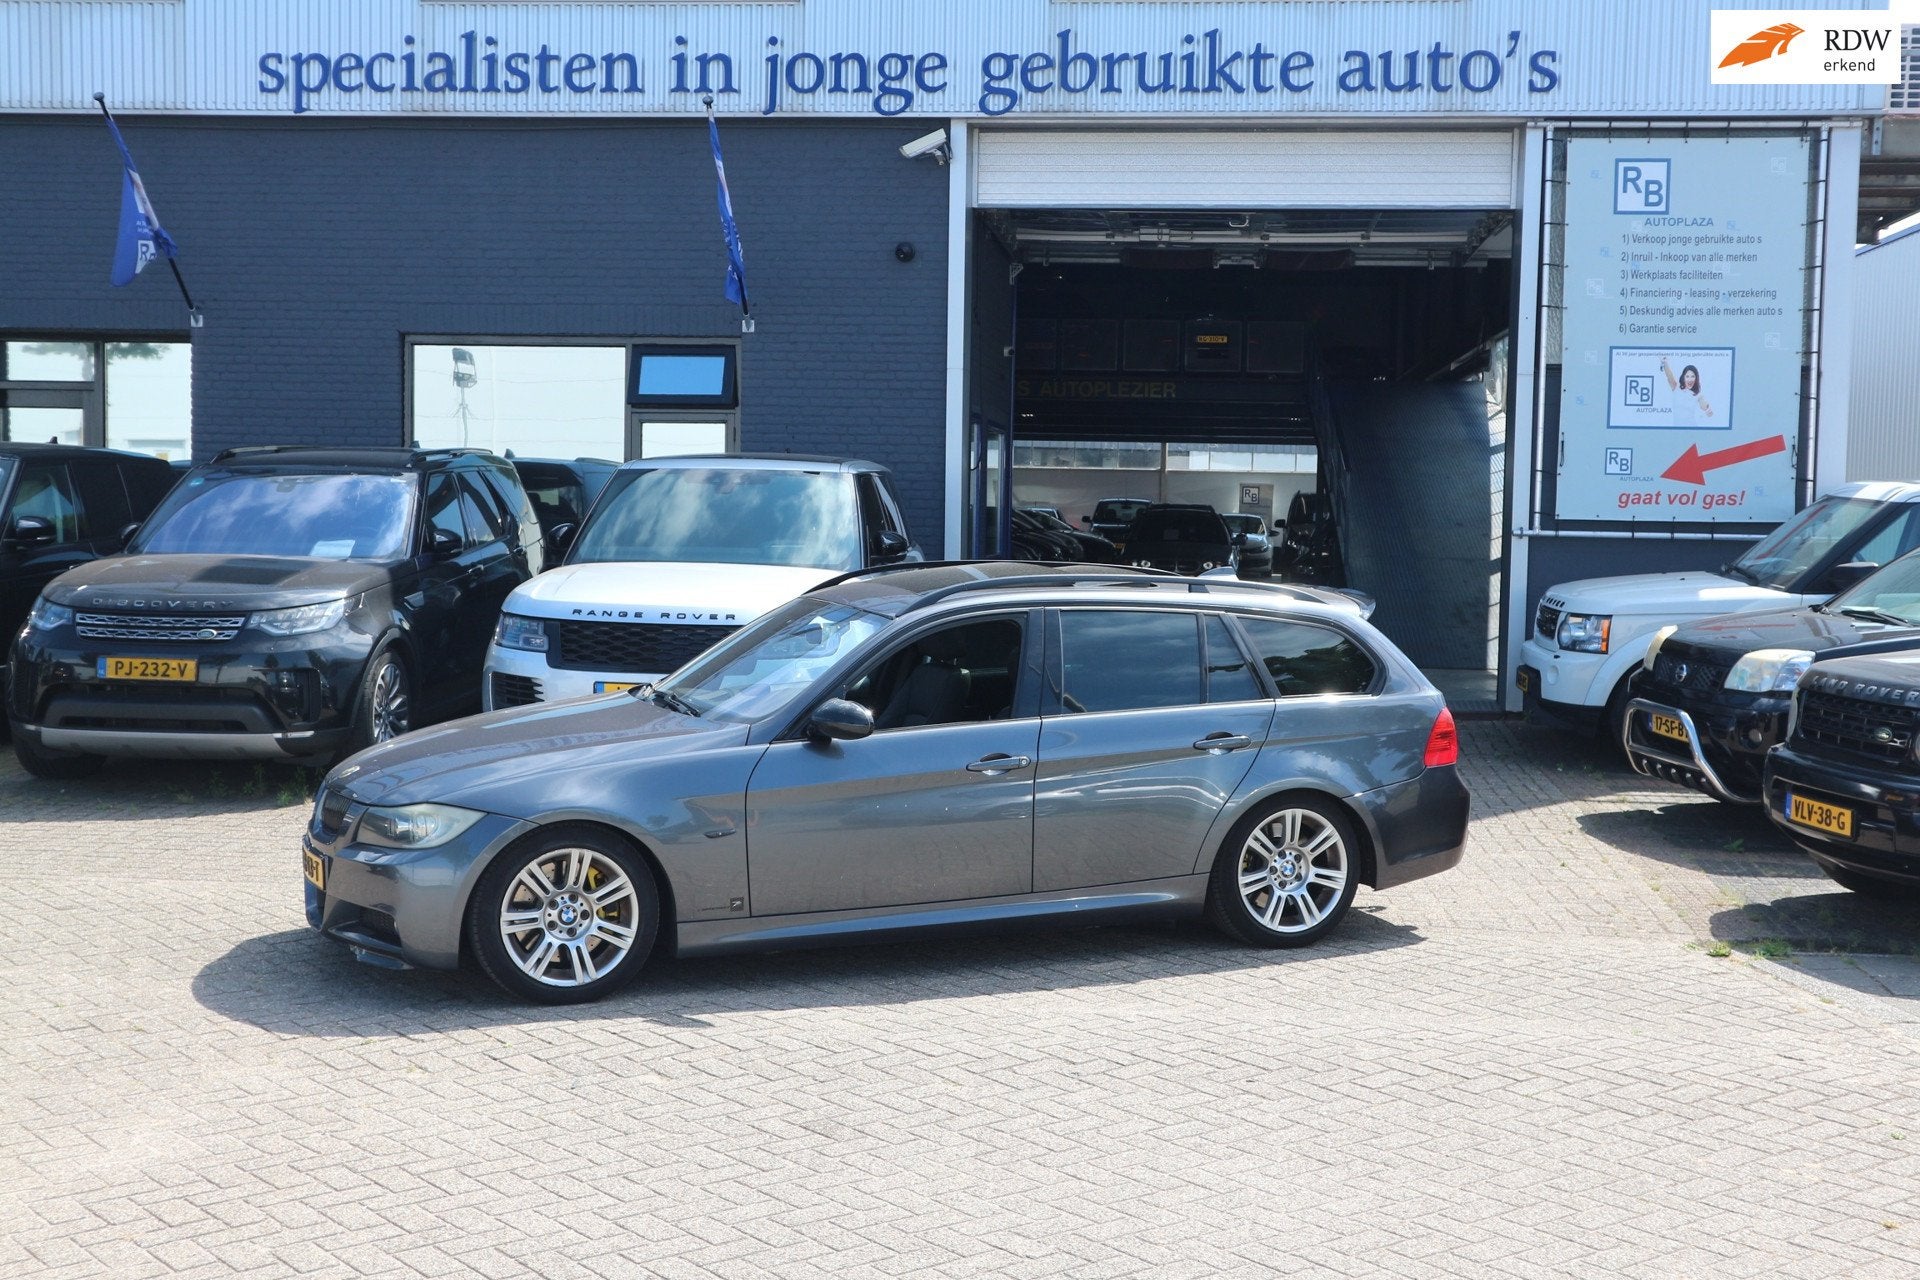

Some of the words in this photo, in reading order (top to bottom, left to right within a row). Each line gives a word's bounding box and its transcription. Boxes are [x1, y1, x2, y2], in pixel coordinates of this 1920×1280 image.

[258, 30, 645, 114] specialisten
[670, 35, 739, 93] in
[762, 35, 948, 116] jonge
[978, 28, 1315, 116] gebruikte
[1622, 166, 1664, 207] RB
[1644, 217, 1714, 227] AUTOPLAZA
[1622, 234, 1630, 245] 1)
[1632, 234, 1666, 246] Verkoop
[1668, 234, 1692, 246] jonge
[1694, 234, 1734, 246] gebruikte
[1621, 252, 1629, 263] 2)
[1632, 252, 1652, 261] Inruil
[1660, 252, 1689, 263] Inkoop
[1692, 254, 1706, 262] van
[1709, 252, 1724, 262] alle
[1726, 252, 1758, 262] merken
[1620, 270, 1628, 281] 3)
[1630, 270, 1676, 281] Werkplaats
[1680, 270, 1723, 280] faciliteiten
[1620, 288, 1628, 299] 4)
[1630, 288, 1682, 300] Financiering
[1690, 288, 1720, 300] leasing
[1728, 288, 1776, 300] verzekering
[1620, 306, 1628, 317] 5)
[1630, 306, 1674, 318] Deskundig
[1676, 306, 1704, 316] advies
[1706, 306, 1721, 316] alle
[1723, 306, 1754, 316] merken
[1757, 307, 1775, 316] auto
[1778, 308, 1782, 316] s
[1619, 324, 1626, 335] 6)
[1629, 323, 1664, 333] Garantie
[1666, 324, 1697, 333] service
[1040, 380, 1177, 398] AUTOPLEZIER
[1629, 380, 1650, 402] RB
[1609, 452, 1630, 472] RB
[1244, 488, 1258, 502] RB
[1618, 490, 1662, 508] gaat
[1667, 490, 1698, 506] vol
[1702, 490, 1746, 510] gas!
[572, 608, 643, 618] RANGE
[660, 612, 736, 620] ROVER
[114, 660, 188, 678] PJ-232-V
[1794, 798, 1846, 830] VLV-38-G
